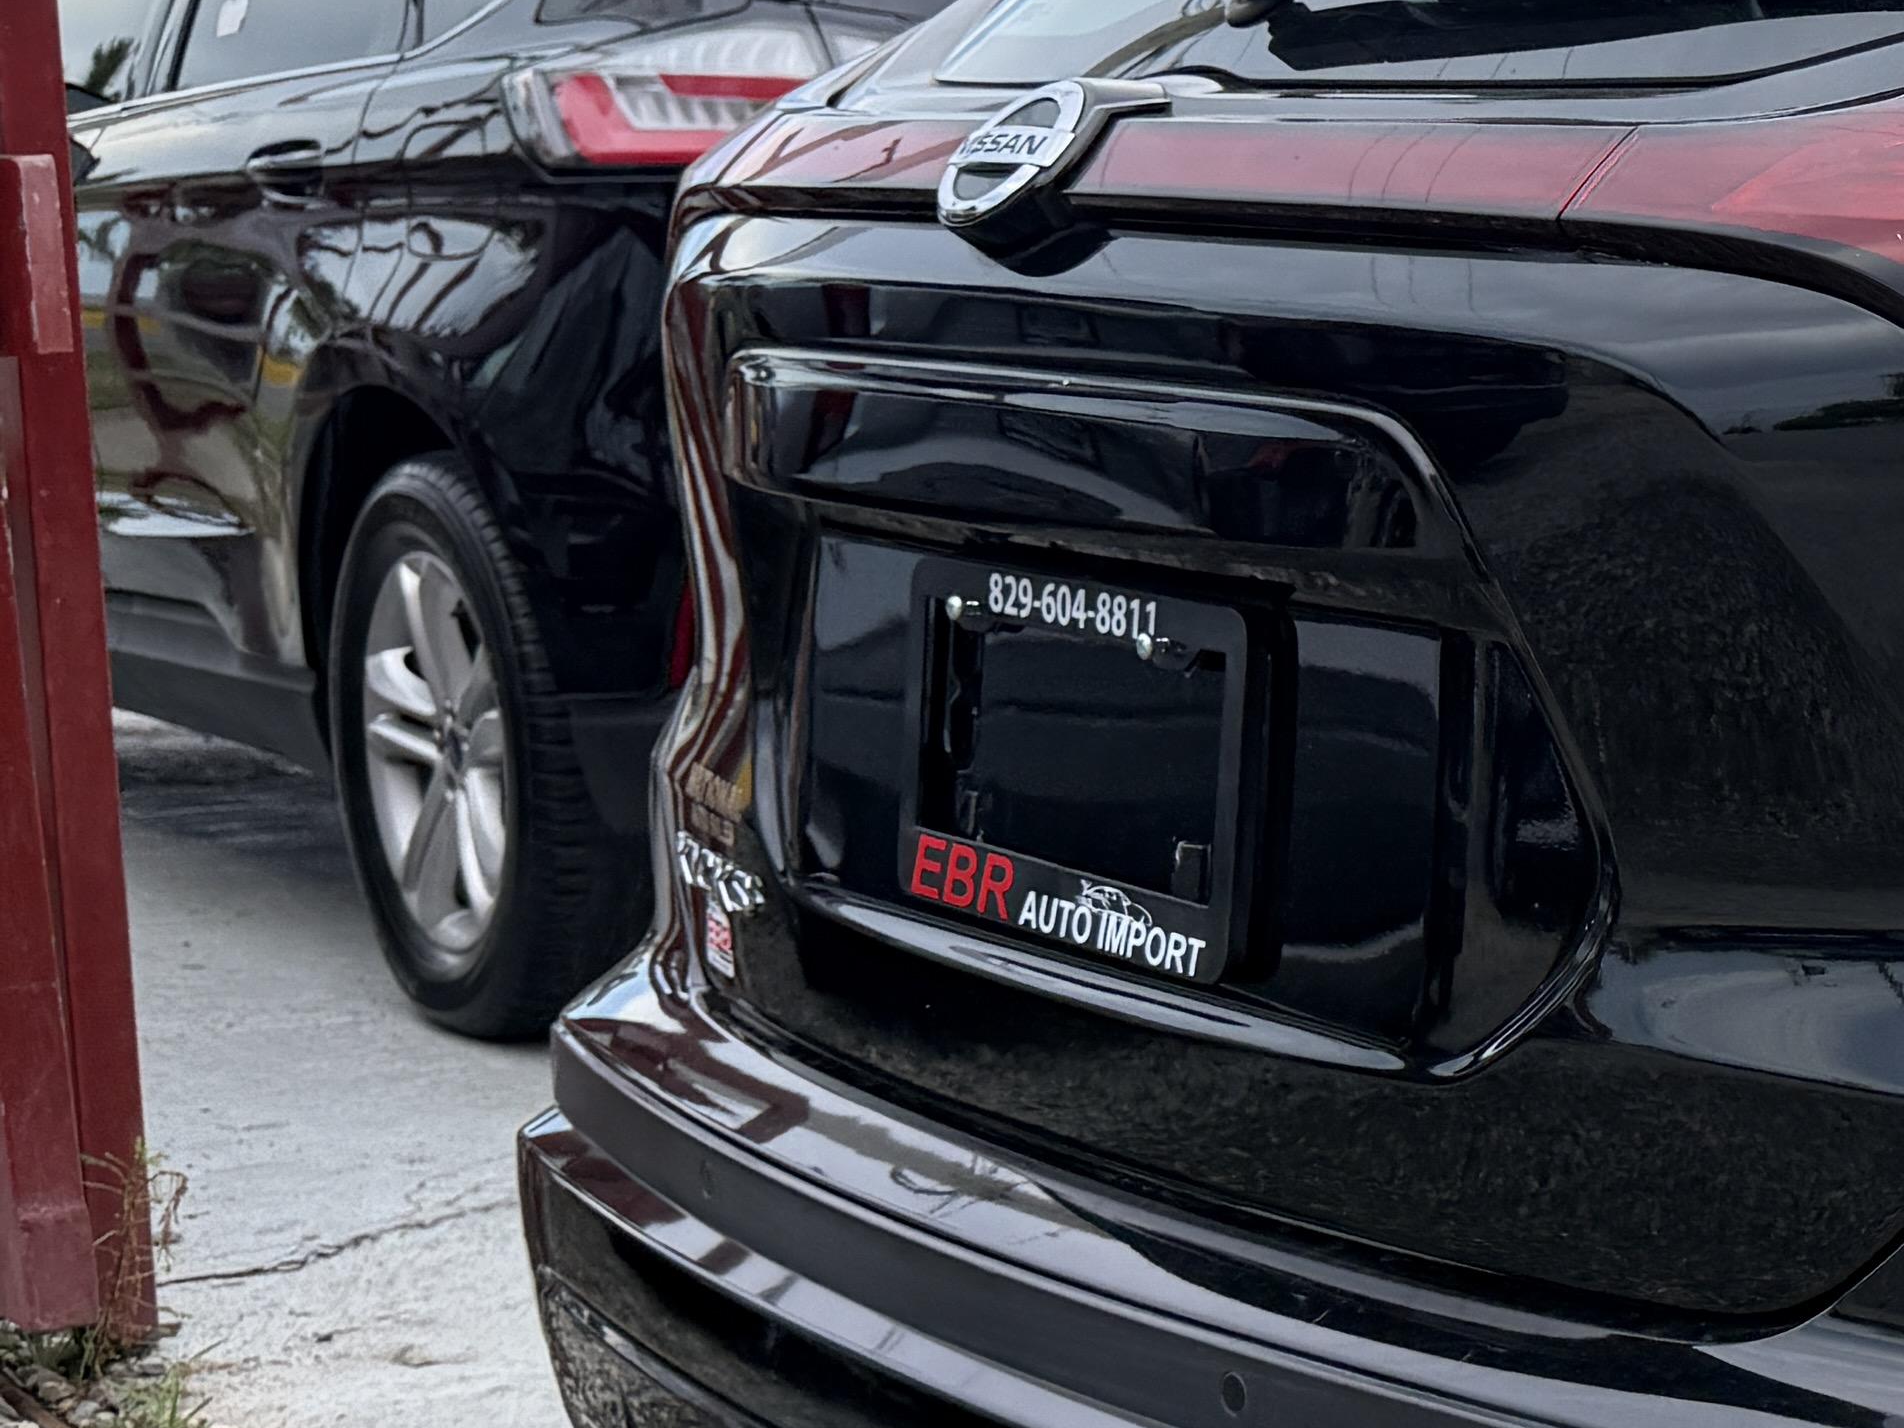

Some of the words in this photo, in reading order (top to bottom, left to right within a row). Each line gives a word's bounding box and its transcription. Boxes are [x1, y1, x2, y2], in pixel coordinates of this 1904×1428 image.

[988, 572, 1157, 640] 829-604-8811
[909, 833, 1015, 921] EBR
[1017, 890, 1092, 945] AUTO
[1096, 912, 1207, 978] IMPORT
